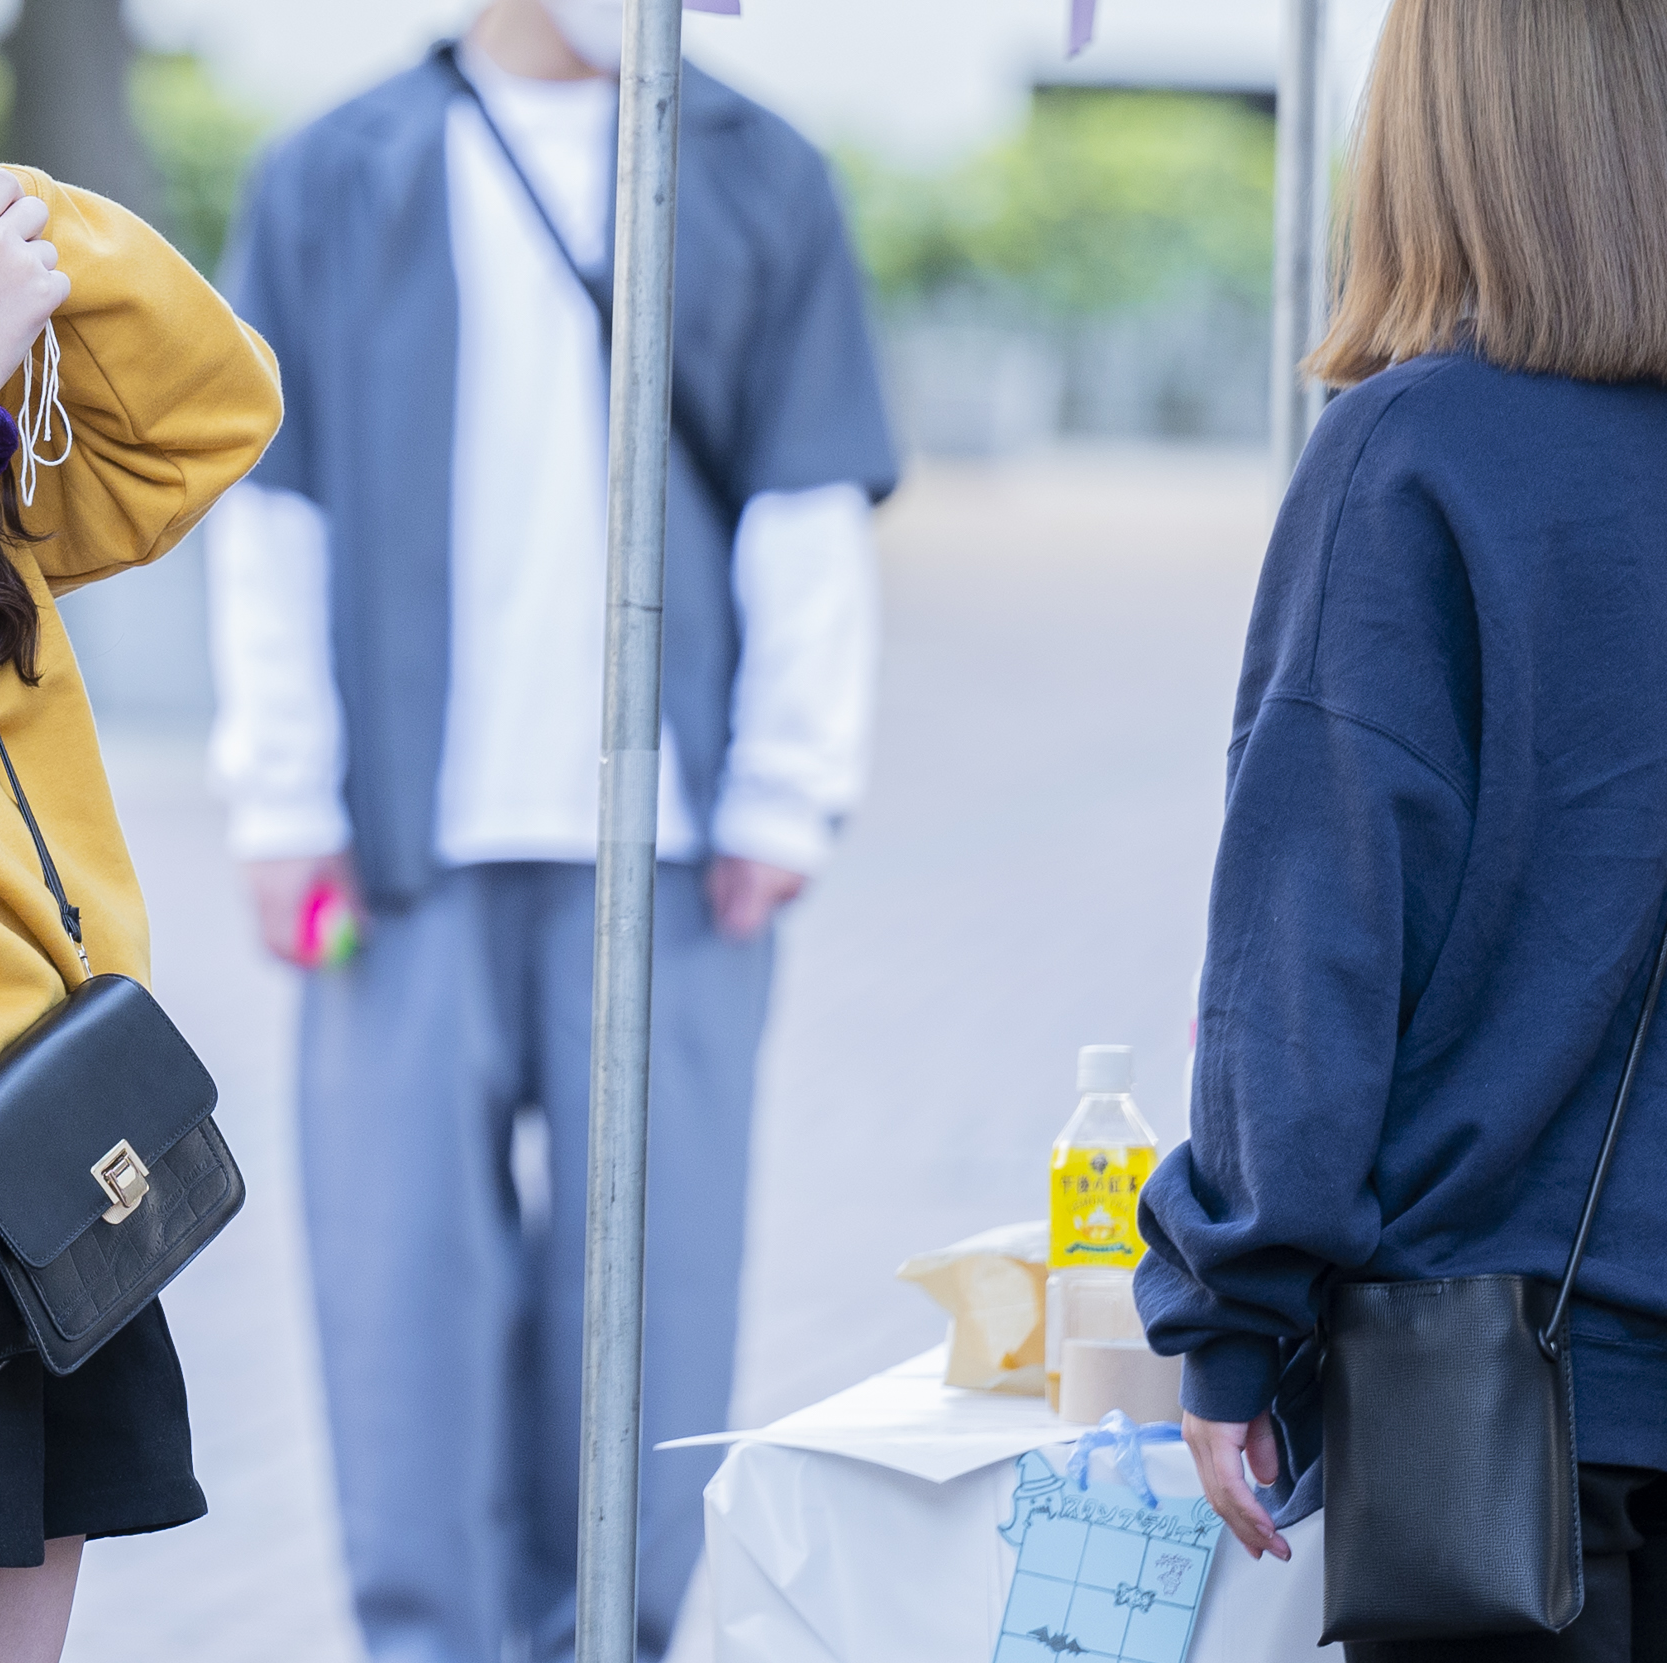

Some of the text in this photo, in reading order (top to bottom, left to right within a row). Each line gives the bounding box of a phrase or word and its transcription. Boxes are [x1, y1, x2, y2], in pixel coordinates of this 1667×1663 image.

[1061, 1174, 1138, 1195] 午後の紅茶
